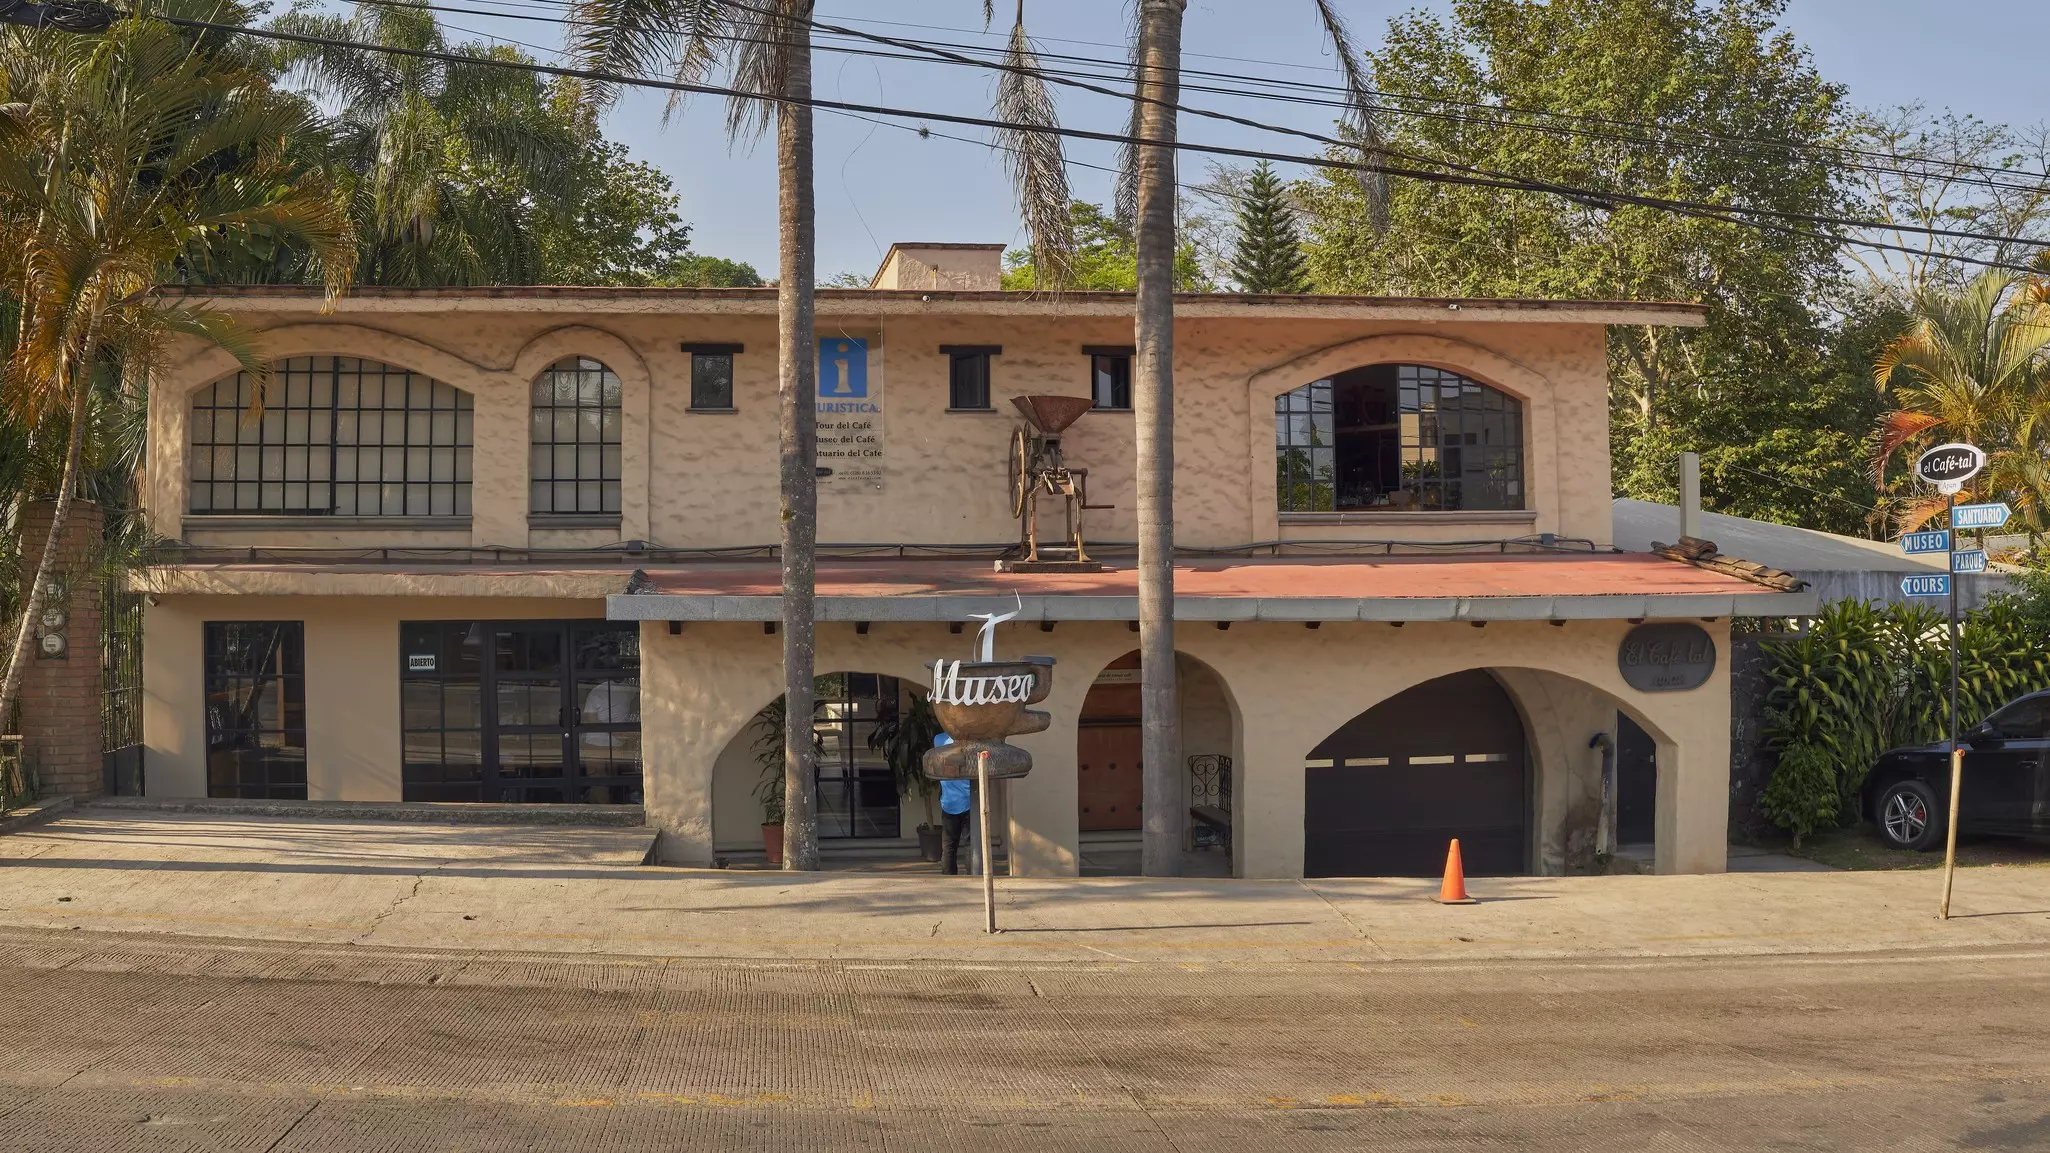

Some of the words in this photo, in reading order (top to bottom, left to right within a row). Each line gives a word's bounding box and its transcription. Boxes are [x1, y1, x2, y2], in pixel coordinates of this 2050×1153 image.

[816, 402, 877, 413] URISTICA
[836, 421, 849, 429] del
[852, 421, 871, 429] Café
[840, 435, 853, 443] del
[856, 435, 875, 443] Café
[847, 449, 860, 457] del
[863, 449, 882, 457] Café
[1923, 462, 1931, 474] el
[1932, 452, 1973, 474] Café-tal
[1957, 508, 2002, 525] SANTUARIO
[1904, 534, 1943, 551] MUSEO
[1955, 553, 1983, 570] PARQUE
[1905, 578, 1944, 593] TOURS
[410, 657, 435, 667] ABIERTO
[926, 658, 1034, 706] Museo
